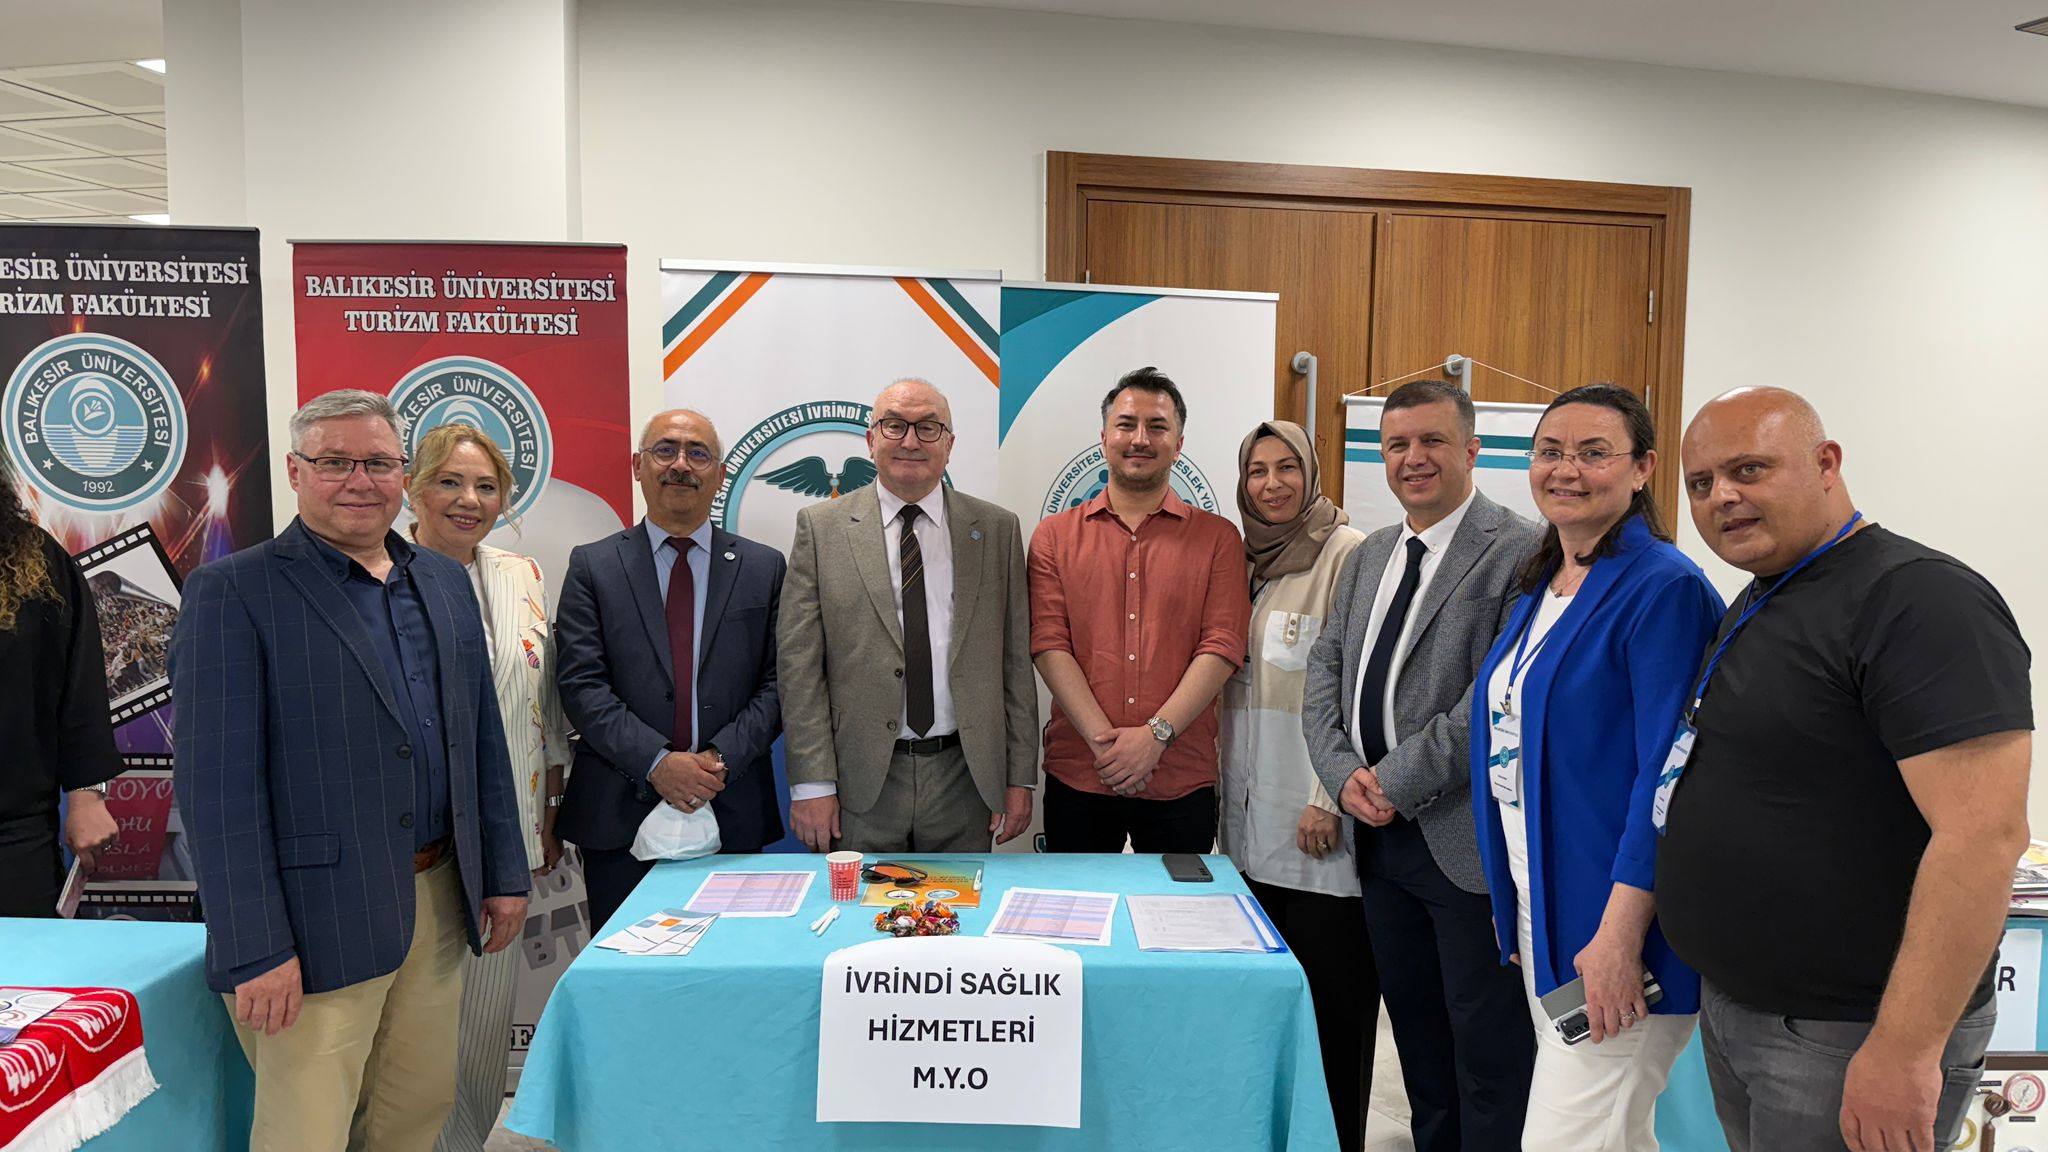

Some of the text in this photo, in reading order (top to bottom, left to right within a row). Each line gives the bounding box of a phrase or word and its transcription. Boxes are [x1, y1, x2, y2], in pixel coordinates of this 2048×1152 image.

[0, 252, 249, 284] ESİR ÜNİVERSİTESİ
[305, 270, 616, 301] BALIKESİR ÜNİVERSİTESİ
[0, 286, 211, 318] RİZM FAKÜLTESİ
[344, 304, 579, 335] TURİZM FAKÜLTESİ
[23, 352, 170, 447] BALIKESİR ÜNİVERSİTESİ
[807, 402, 861, 420] İVRİNDİ
[453, 375, 536, 471] ÜNİVERSİTESİ
[82, 481, 115, 493] 1992
[1173, 459, 1205, 494] ESLEK
[117, 816, 152, 832] HU
[845, 966, 1062, 996] İVRİNDİ SAĞLIK
[1997, 966, 2016, 991] R
[868, 1013, 1035, 1043] HİZMETLERİ
[913, 1066, 988, 1090] M.Y.O
